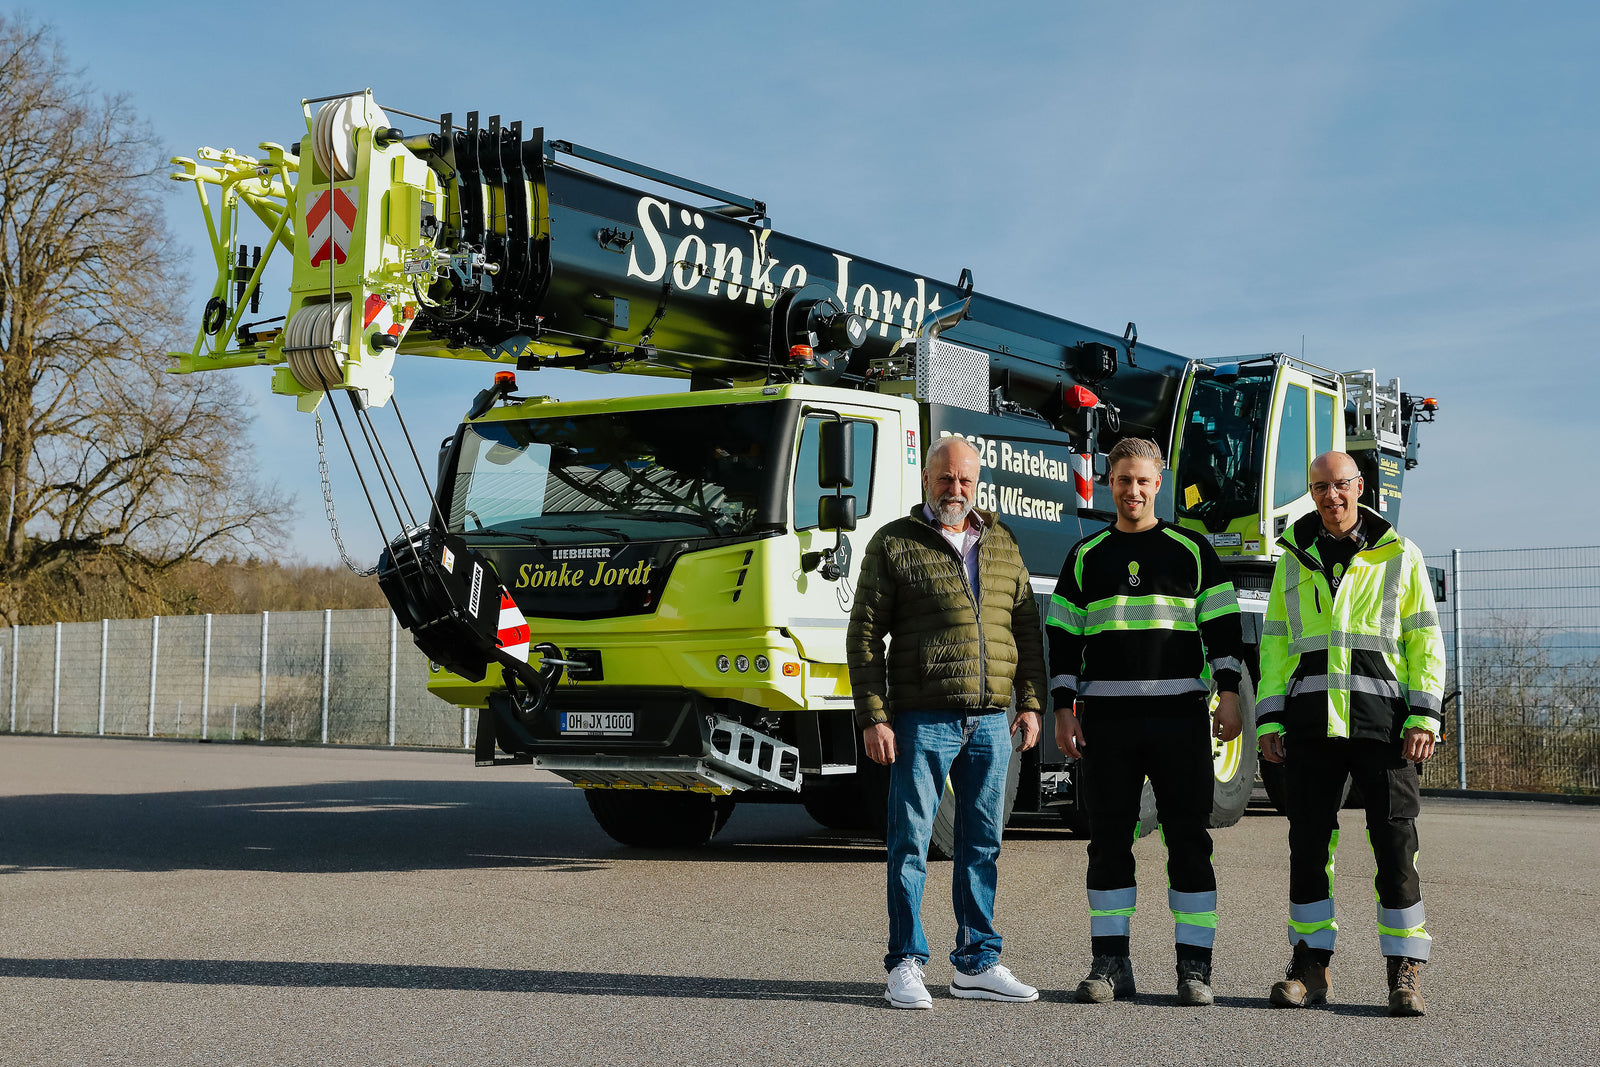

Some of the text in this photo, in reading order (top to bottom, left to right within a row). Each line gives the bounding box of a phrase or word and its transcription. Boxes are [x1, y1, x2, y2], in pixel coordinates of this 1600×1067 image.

[1001, 442, 1068, 482] Ratekau
[1000, 485, 1064, 522] Wismar
[552, 547, 611, 560] LIEBHERR
[470, 566, 482, 614] LIEBHERR
[515, 560, 652, 588] Sönke Jordt
[569, 715, 582, 729] OH
[589, 715, 603, 729] JX
[605, 715, 632, 729] 1000
